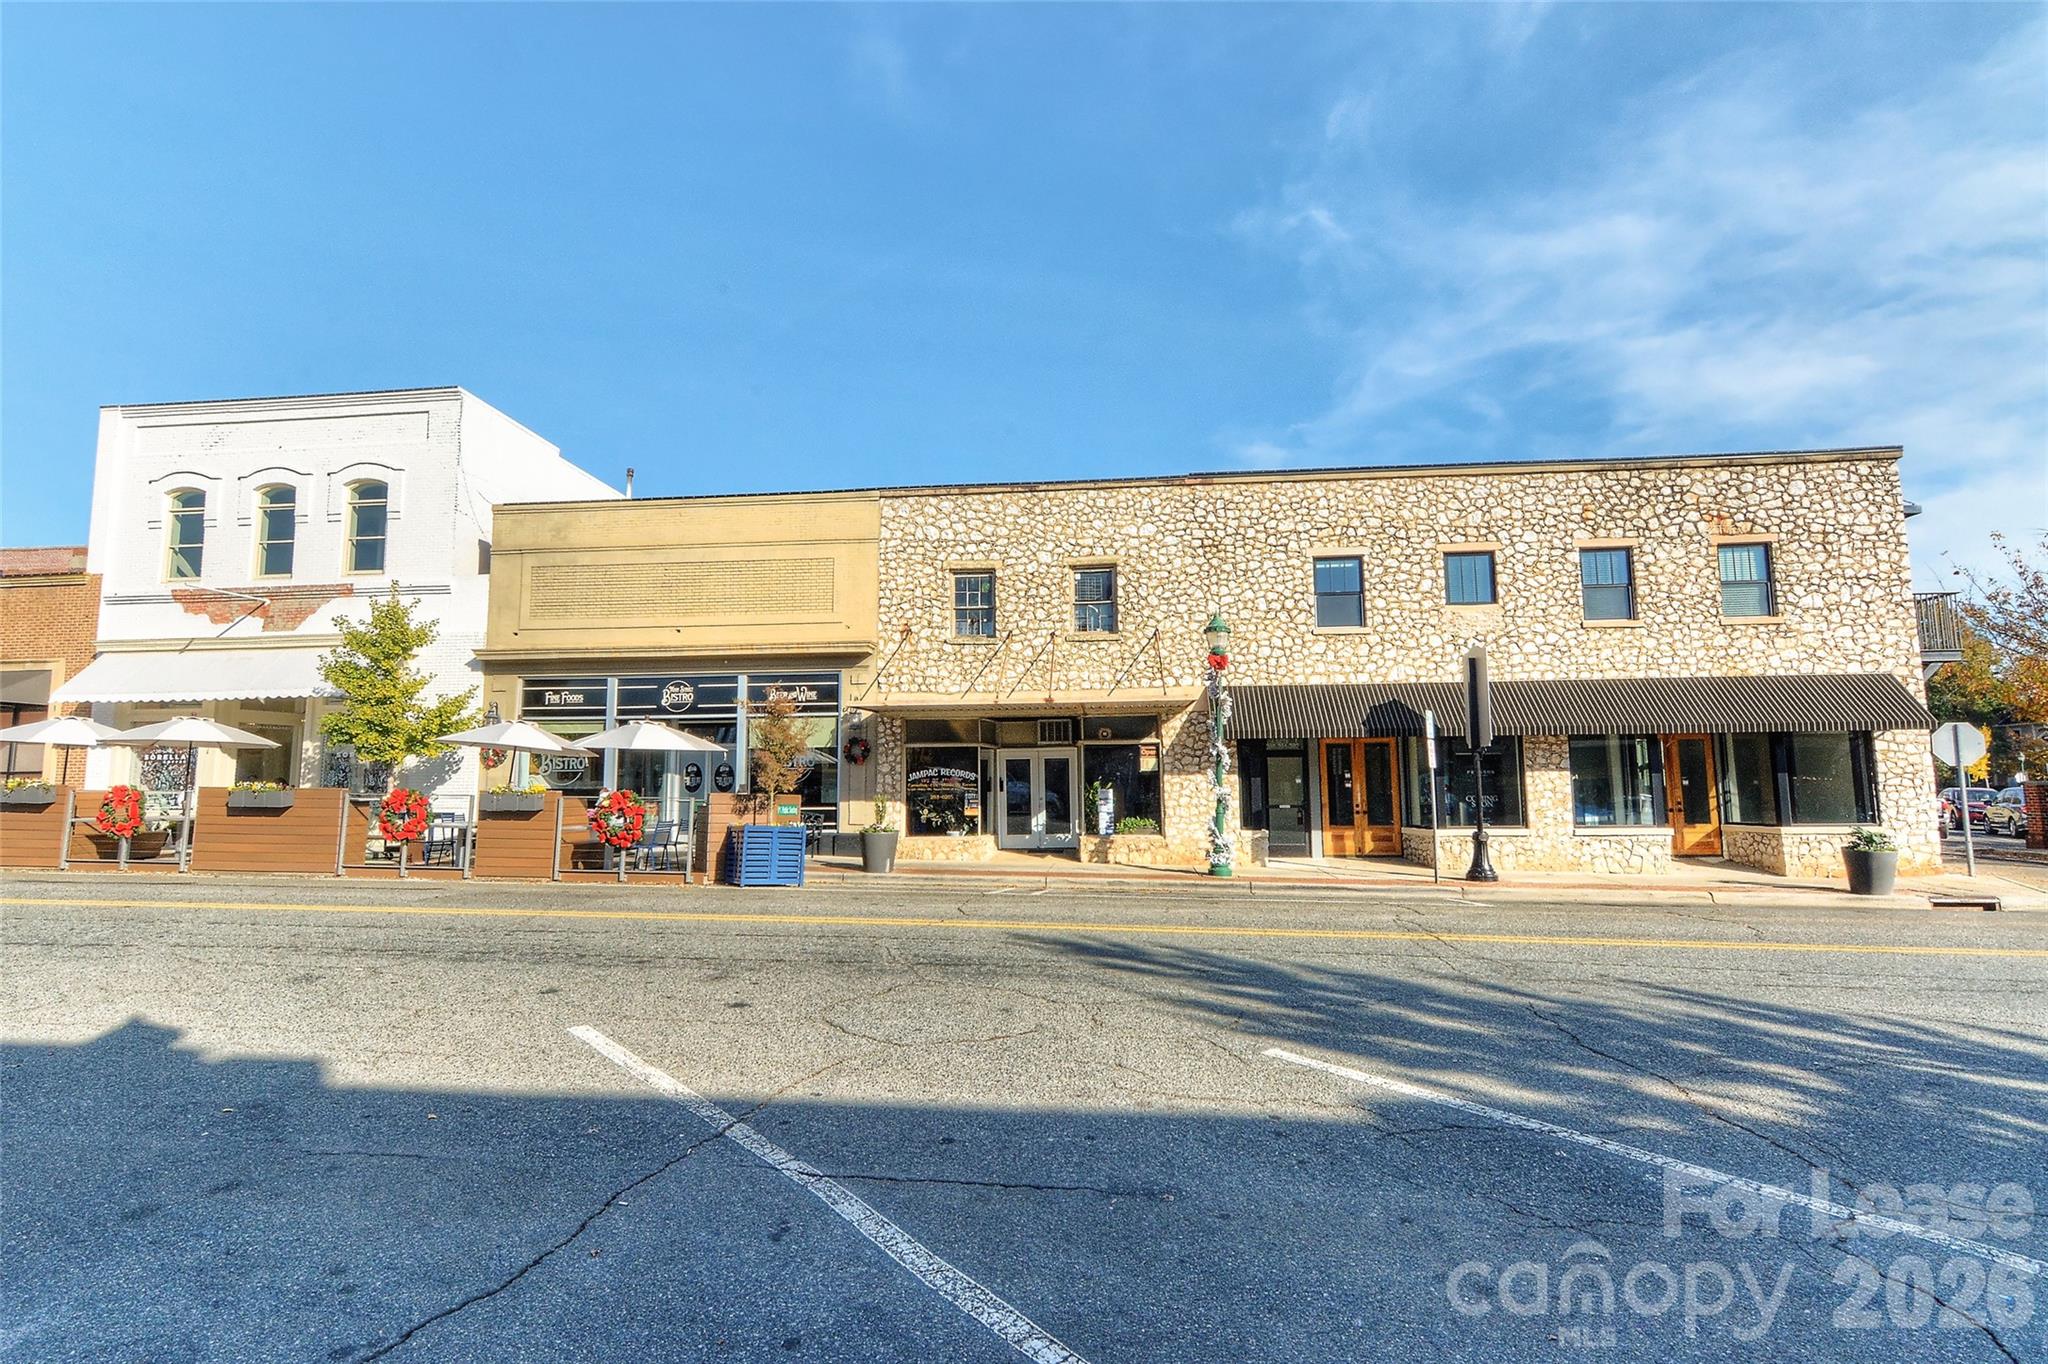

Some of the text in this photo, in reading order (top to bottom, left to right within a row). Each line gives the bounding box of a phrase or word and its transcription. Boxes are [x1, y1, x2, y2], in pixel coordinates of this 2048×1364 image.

[561, 691, 584, 705] FOODS
[661, 689, 694, 706] BISTRO
[144, 753, 187, 761] SORELLA
[539, 753, 586, 776] BISTRO
[907, 768, 939, 782] JAMPAC
[940, 768, 977, 781] RECORDS
